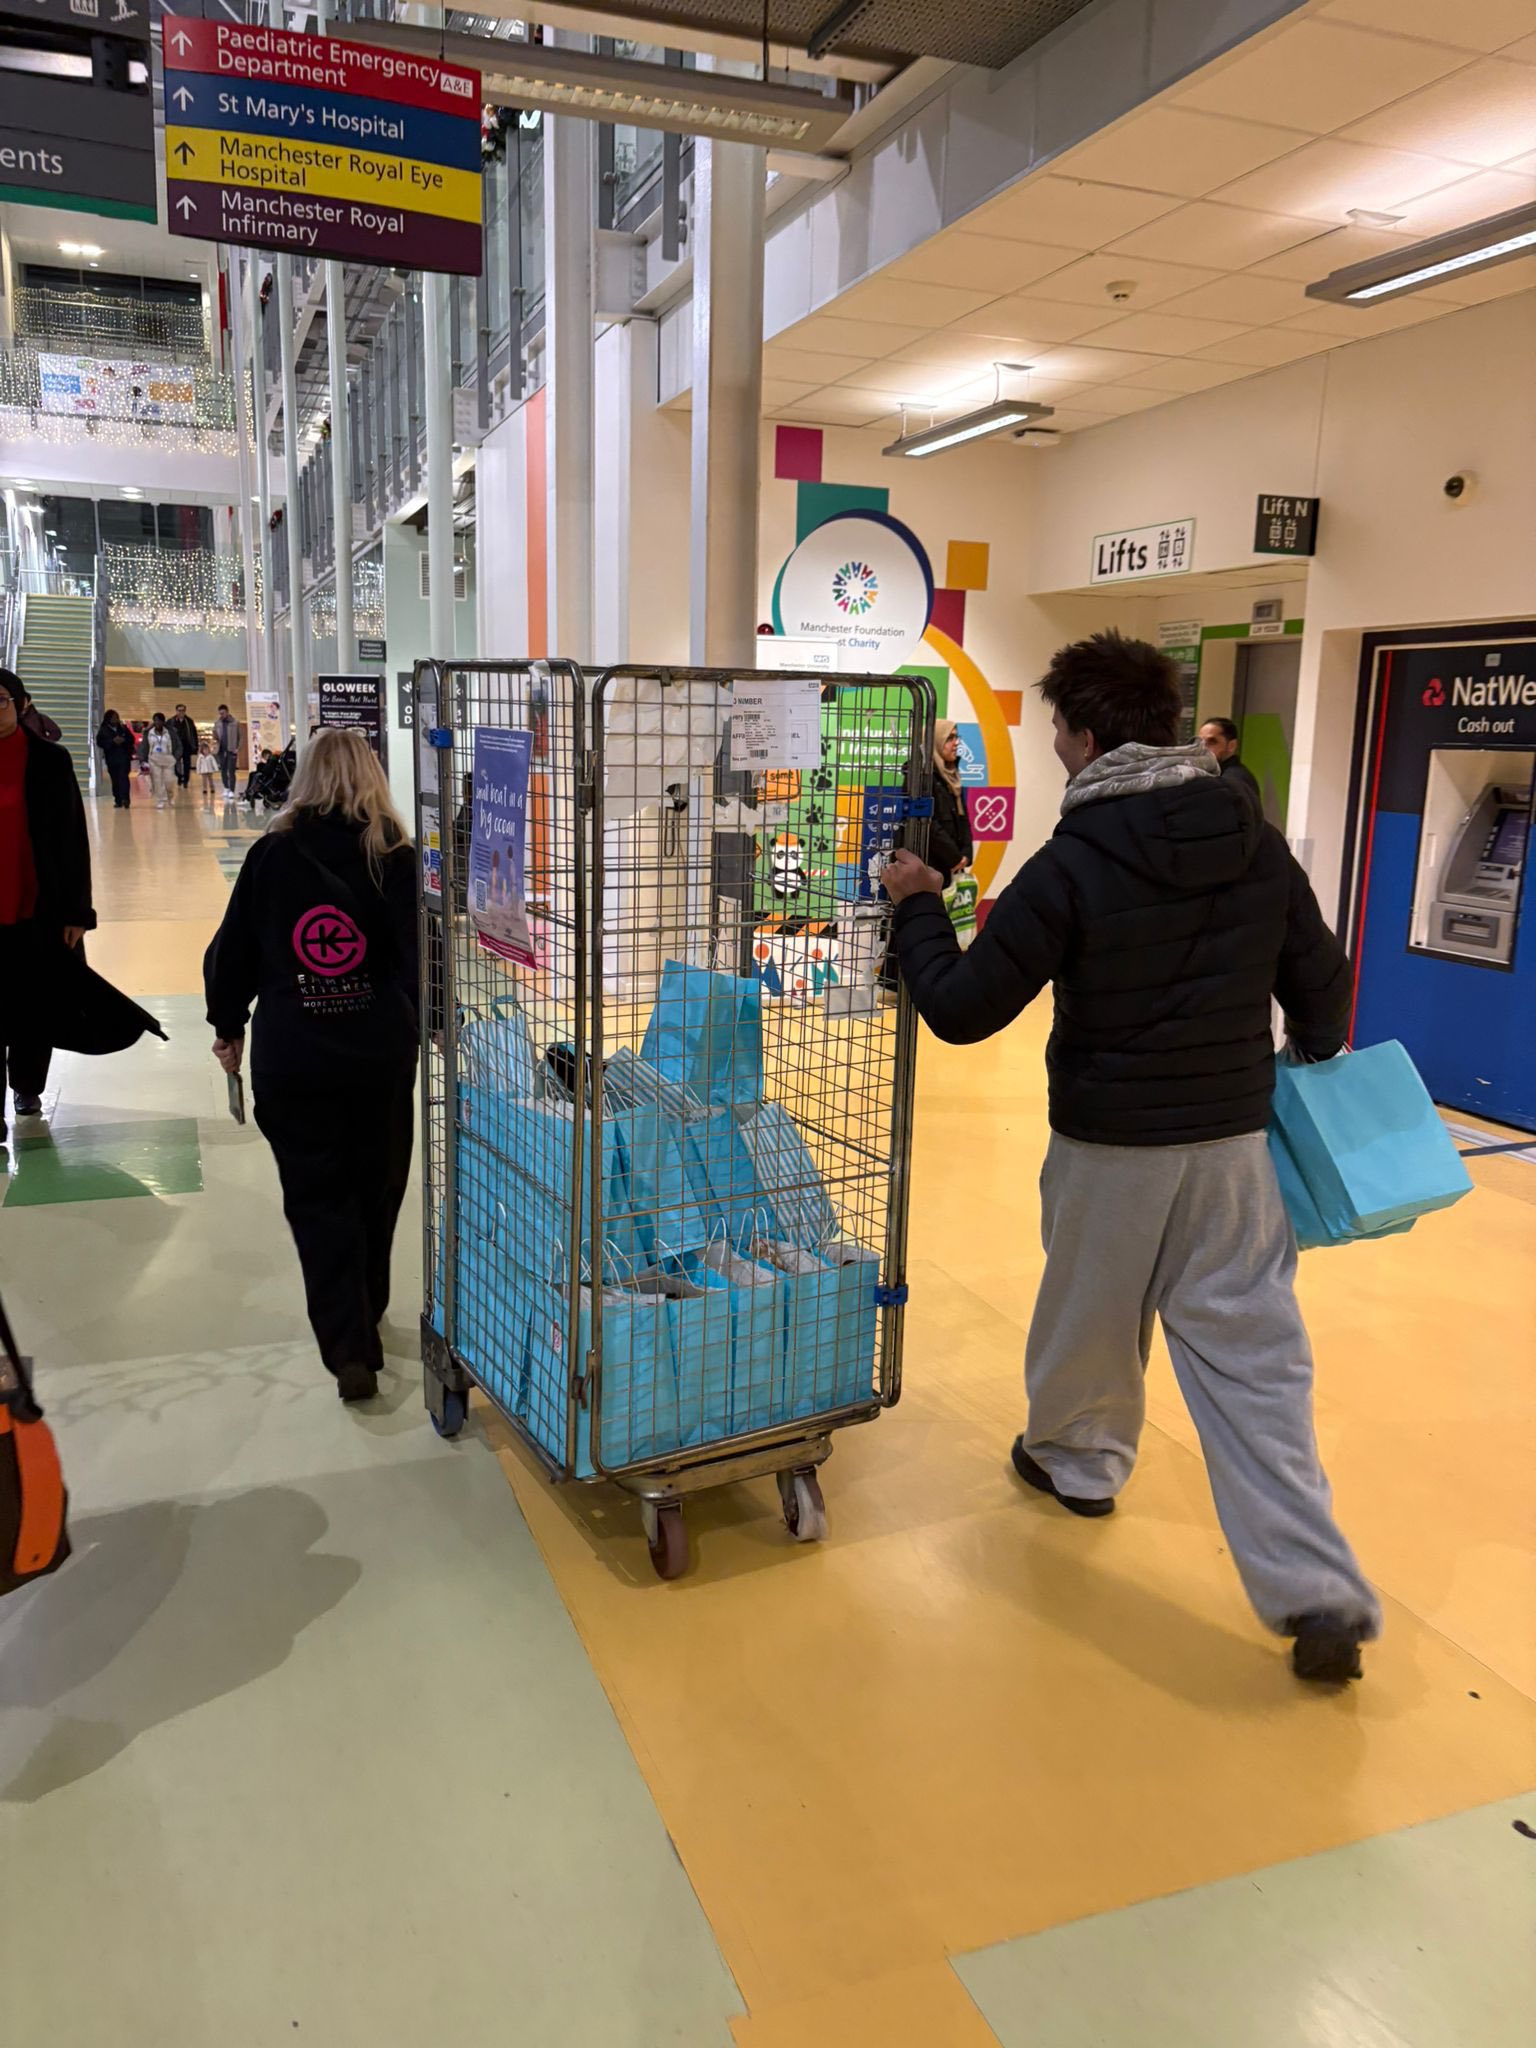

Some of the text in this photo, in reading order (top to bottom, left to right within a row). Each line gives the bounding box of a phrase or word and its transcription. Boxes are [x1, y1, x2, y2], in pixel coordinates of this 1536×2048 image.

[217, 26, 440, 85] Paediatric Emergency
[217, 50, 347, 87] Department
[442, 77, 471, 95] A&E
[218, 93, 404, 140] St Mary's Hospital
[220, 136, 443, 190] Manchester Royal Eye
[220, 160, 306, 187] Hospital
[221, 190, 404, 235] Manchester Royal
[222, 213, 318, 246] Infirmary
[1262, 498, 1308, 517] Lift N
[1097, 538, 1148, 576] Lifts
[800, 622, 905, 637] Manchester Foundation
[848, 638, 880, 650] Charity
[322, 683, 376, 693] GLOWEEK
[737, 697, 762, 705] NUMBER
[1452, 675, 1536, 706] NatWe
[1458, 716, 1515, 733] Cash out
